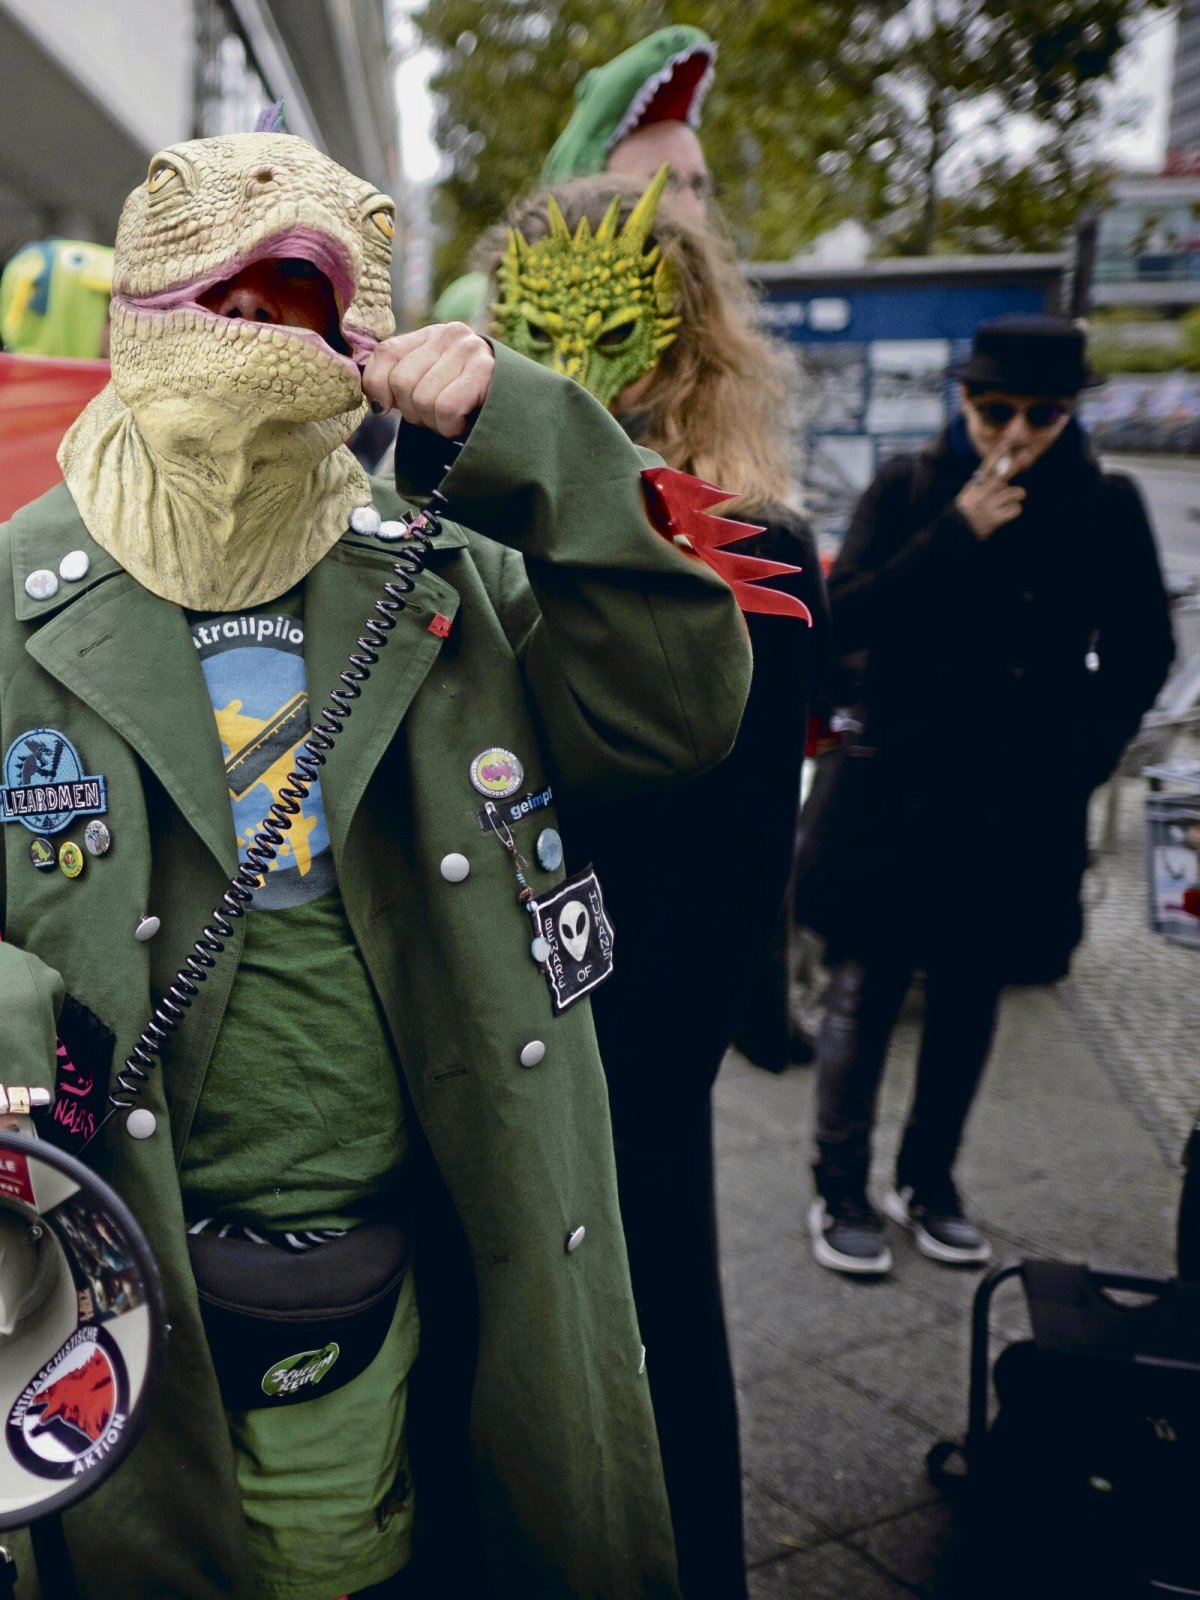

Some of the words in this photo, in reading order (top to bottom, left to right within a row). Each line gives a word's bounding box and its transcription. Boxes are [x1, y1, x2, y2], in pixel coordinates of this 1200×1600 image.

[2, 782, 100, 817] LIZARDMEN
[544, 917, 566, 988] BEWARE
[588, 889, 611, 961] HUMANS
[576, 964, 593, 982] OF
[9, 1326, 98, 1427] ANTIFASCHISTISCHE
[73, 1412, 128, 1475] AKTION
